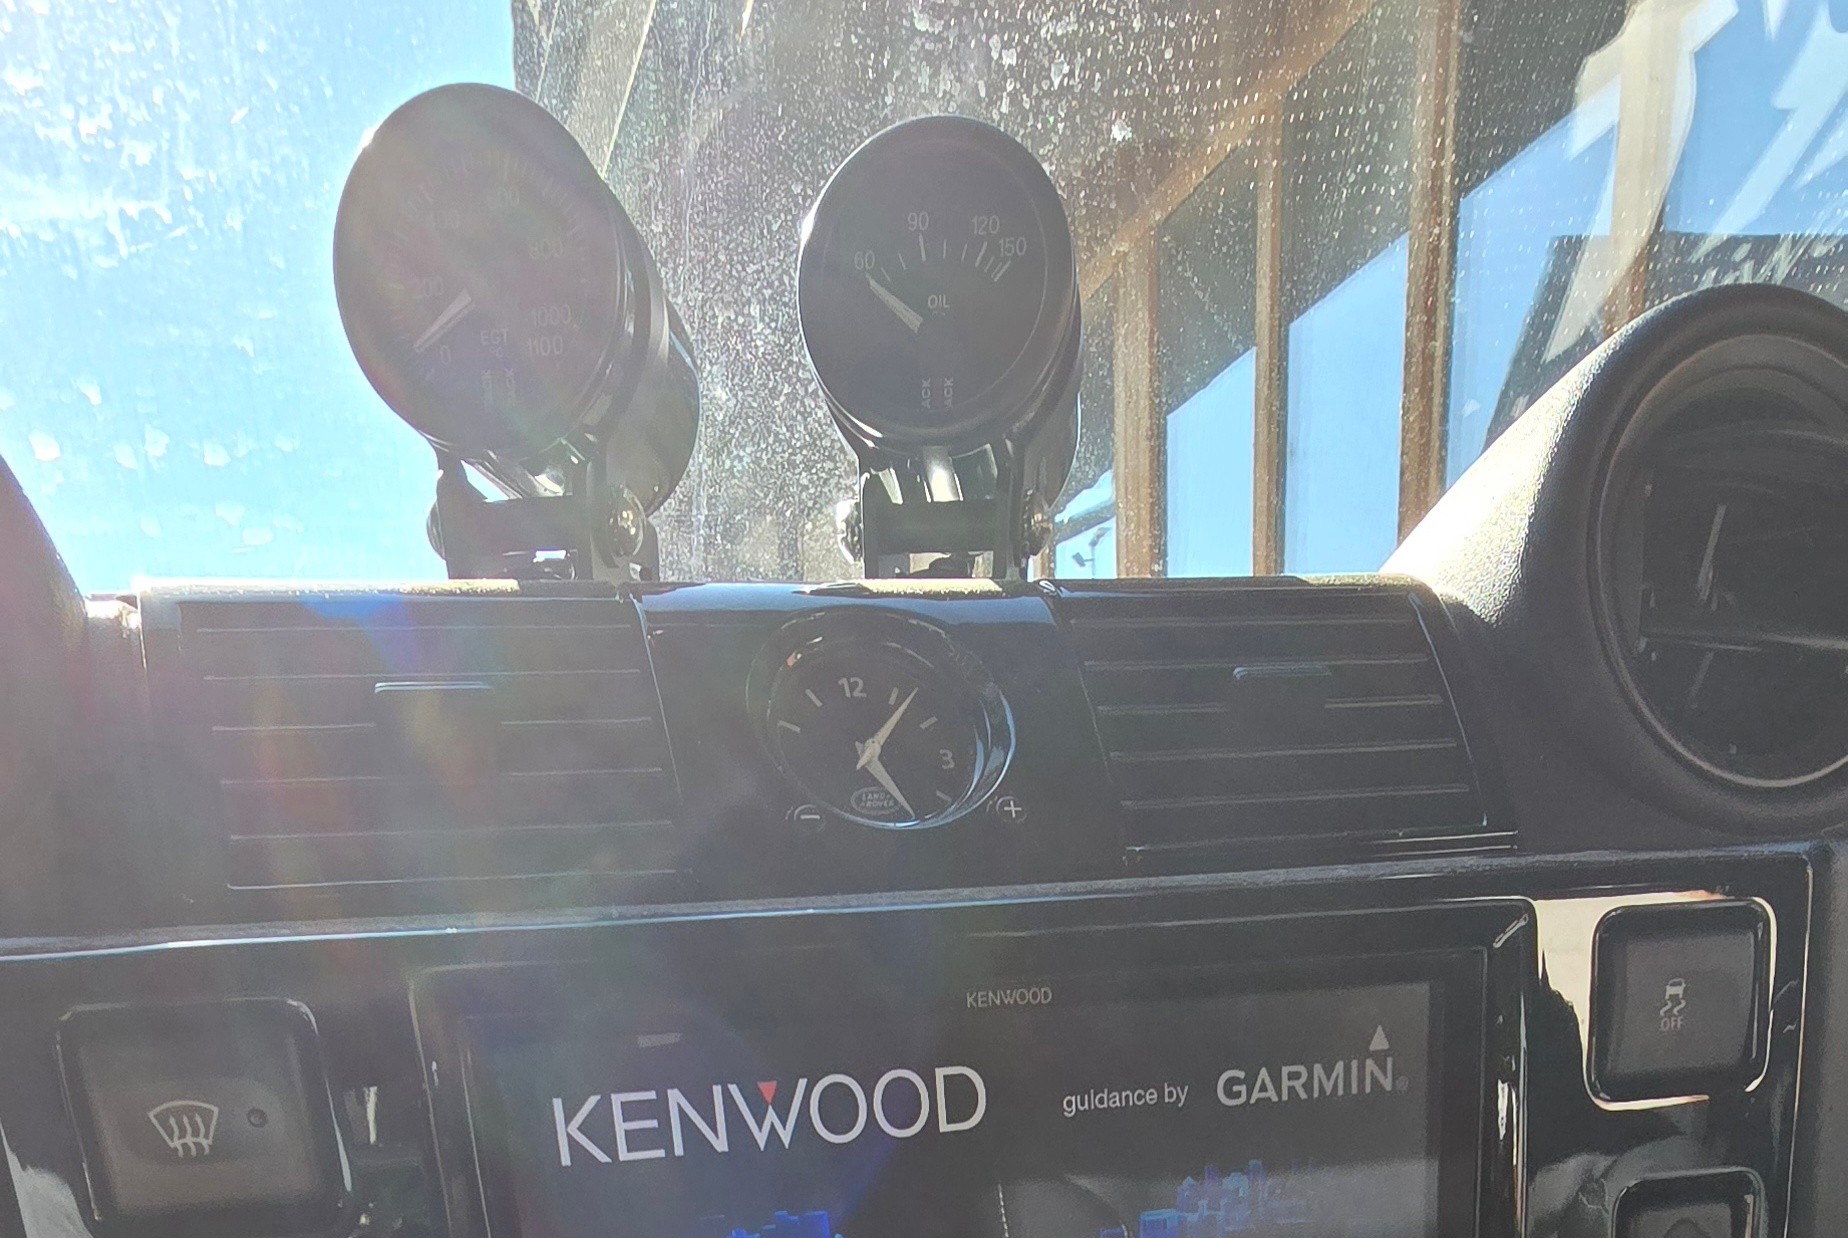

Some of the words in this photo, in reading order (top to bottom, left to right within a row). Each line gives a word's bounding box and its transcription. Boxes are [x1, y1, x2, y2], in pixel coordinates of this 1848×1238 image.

[907, 211, 929, 231] 90
[971, 215, 1000, 235] 120
[998, 236, 1027, 257] 150
[927, 293, 950, 309] OIL
[530, 303, 571, 327] 1000
[480, 327, 509, 346] EGT
[526, 335, 564, 358] 1100
[838, 677, 867, 699] 12
[939, 749, 955, 770] 3
[966, 986, 1053, 1009] KENWOOD
[1660, 1017, 1684, 1032] OFF
[1216, 1056, 1395, 1107] GARMIN
[1062, 1084, 1159, 1118] guidance
[1163, 1081, 1190, 1109] by
[552, 1065, 988, 1168] KENWOOD
